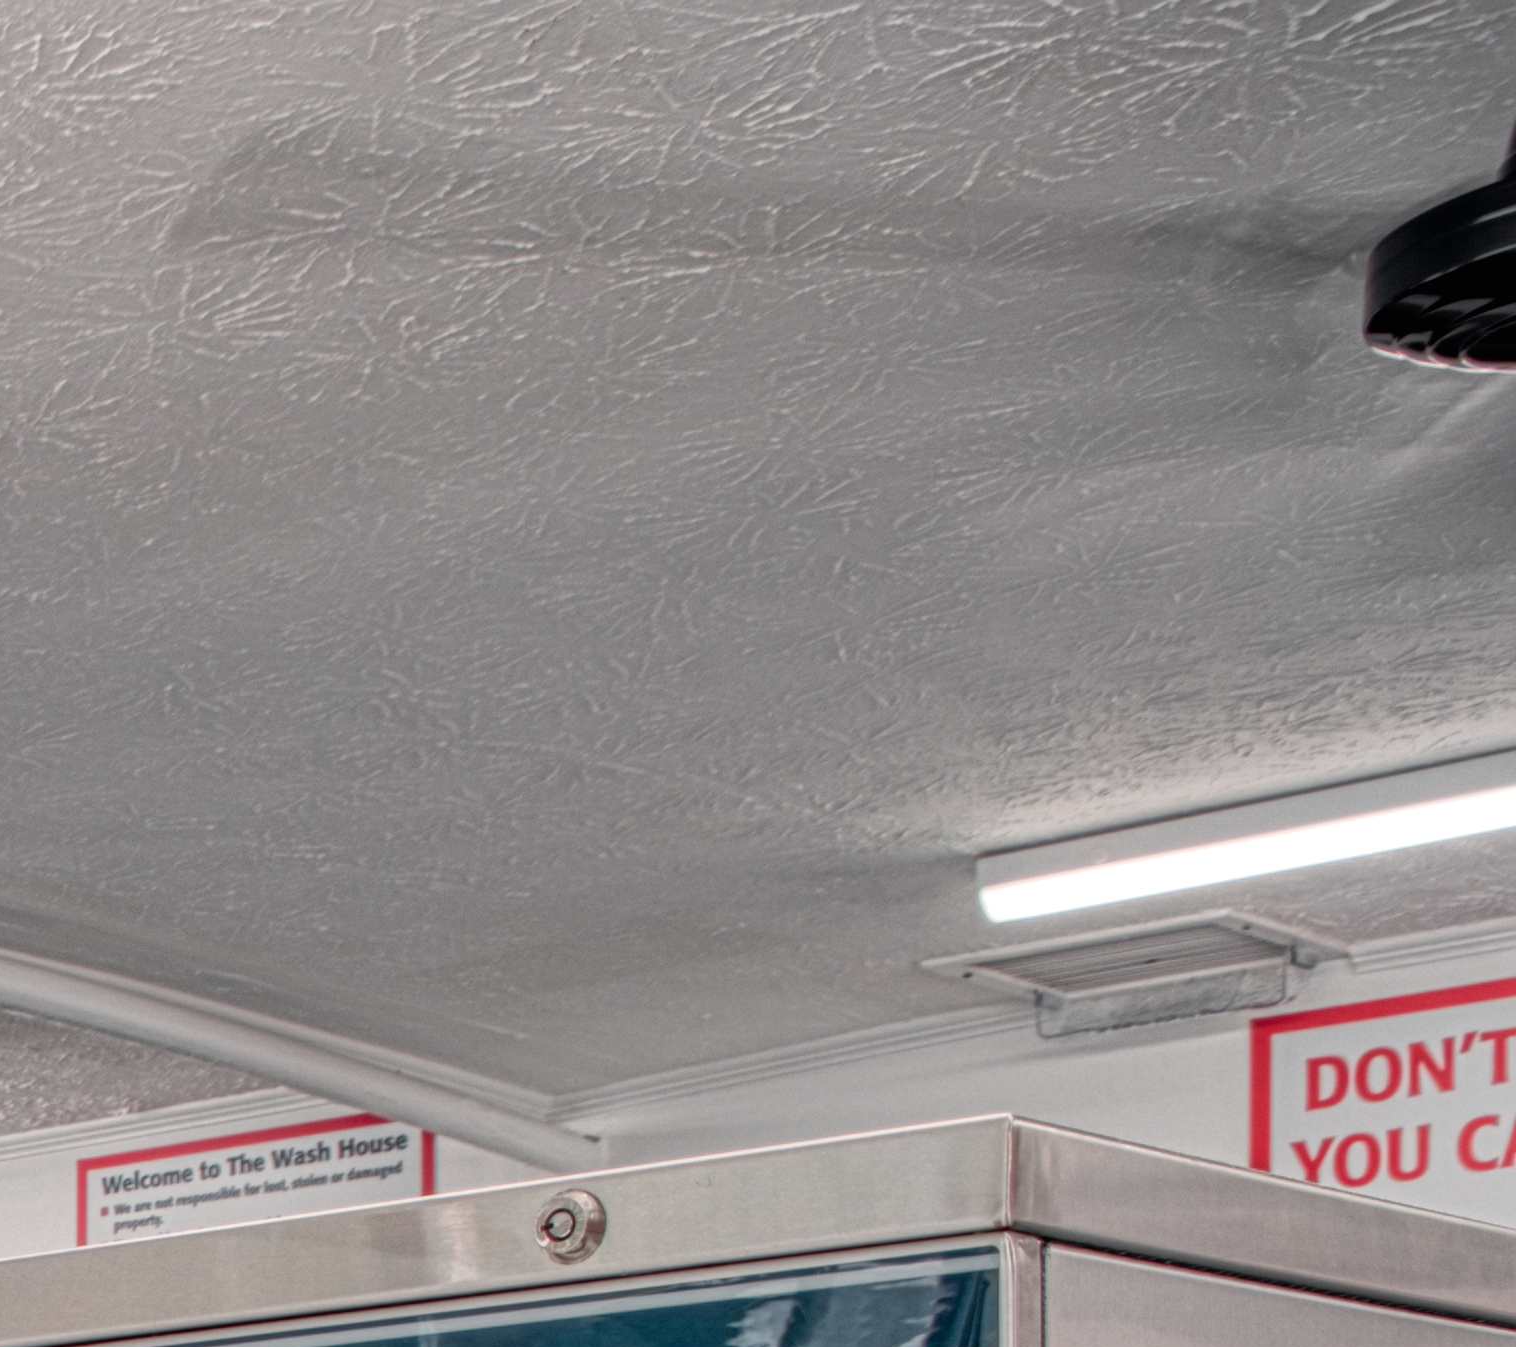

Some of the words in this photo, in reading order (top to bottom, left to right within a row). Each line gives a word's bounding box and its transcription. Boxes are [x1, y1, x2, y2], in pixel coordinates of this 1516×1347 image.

[1306, 1028, 1516, 1112] DON'T
[102, 1170, 193, 1194] Welcome
[200, 1162, 221, 1180] to
[228, 1153, 265, 1176] The
[272, 1142, 330, 1169] Wash
[338, 1134, 408, 1158] House
[176, 1186, 241, 1208] responsible
[292, 1174, 327, 1189] stolen
[332, 1173, 343, 1182] or
[347, 1160, 403, 1180] damaged
[1290, 1124, 1430, 1188] YOU
